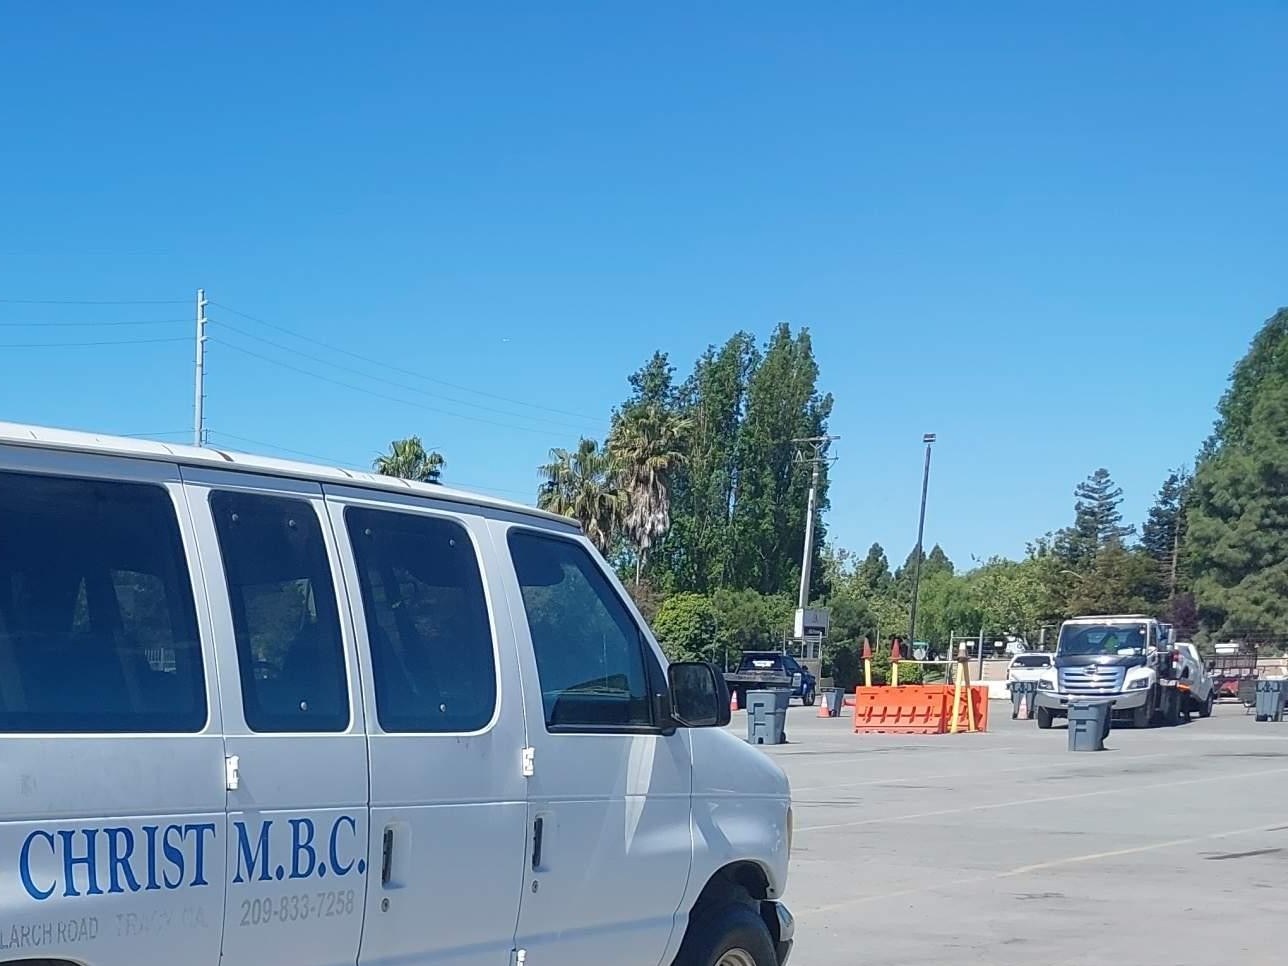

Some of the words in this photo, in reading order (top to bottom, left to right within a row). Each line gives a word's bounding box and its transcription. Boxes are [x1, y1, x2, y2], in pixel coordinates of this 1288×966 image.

[19, 822, 216, 901] CHRIST
[232, 816, 366, 884] M.B.C.
[240, 890, 356, 927] 209-833-7258
[0, 922, 53, 951] LARCH
[57, 916, 99, 946] ROAD
